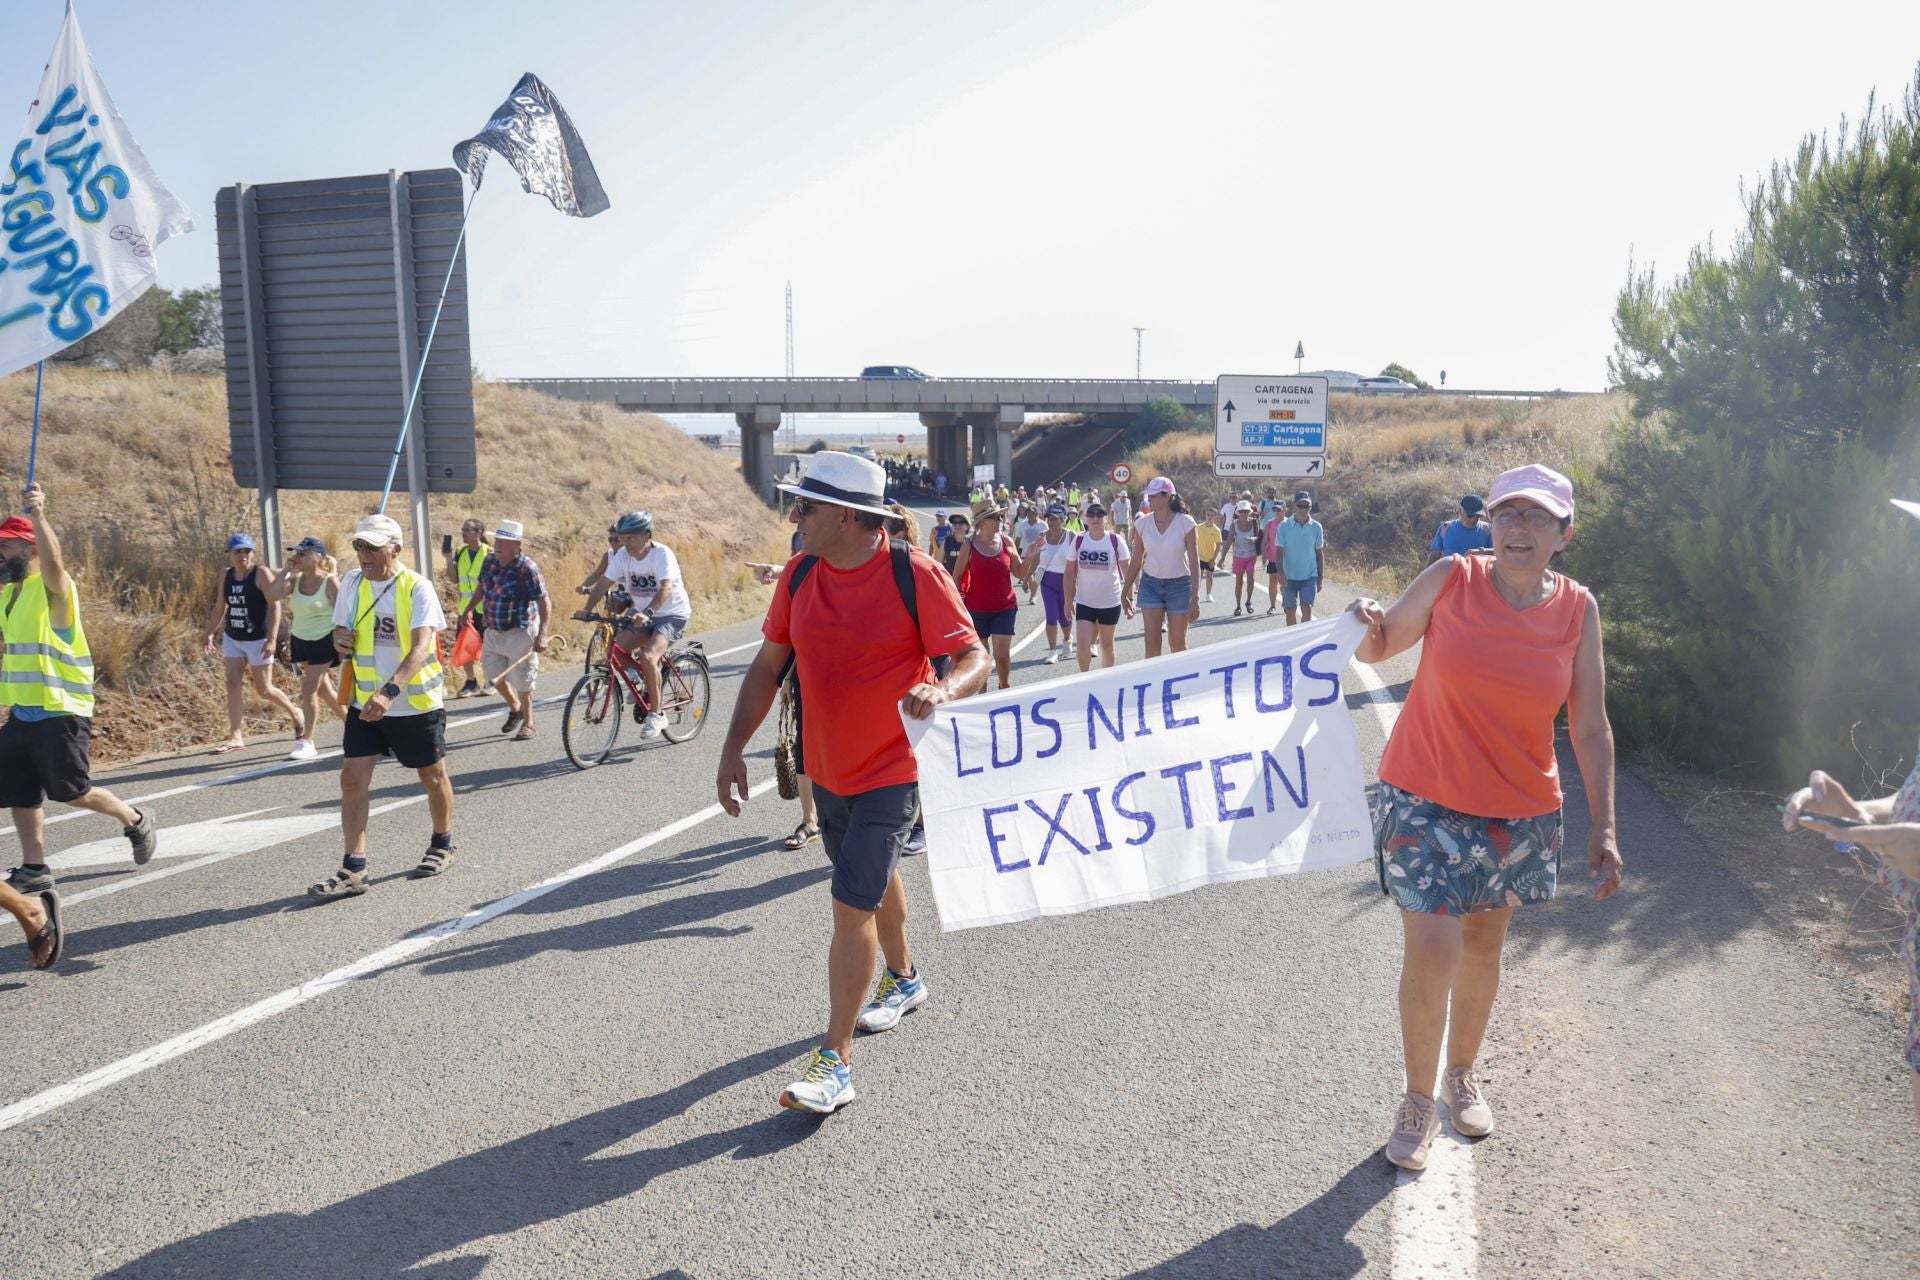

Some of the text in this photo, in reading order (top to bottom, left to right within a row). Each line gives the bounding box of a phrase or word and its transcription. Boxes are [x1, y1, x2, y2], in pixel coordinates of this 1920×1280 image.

[1254, 385, 1314, 395] CARTAGENA
[1271, 397, 1280, 405] de
[1283, 397, 1311, 405] servicio
[1273, 424, 1321, 435] Cartagena
[1273, 436, 1305, 445] Murcia
[1220, 462, 1272, 470] Los Nietos
[1115, 470, 1128, 478] 40
[1079, 550, 1109, 562] SOS
[630, 575, 657, 588] SOS
[950, 643, 1340, 778] LOS NIETOS
[982, 745, 1309, 874] EXISTEN
[1327, 829, 1361, 843] NIETOS
